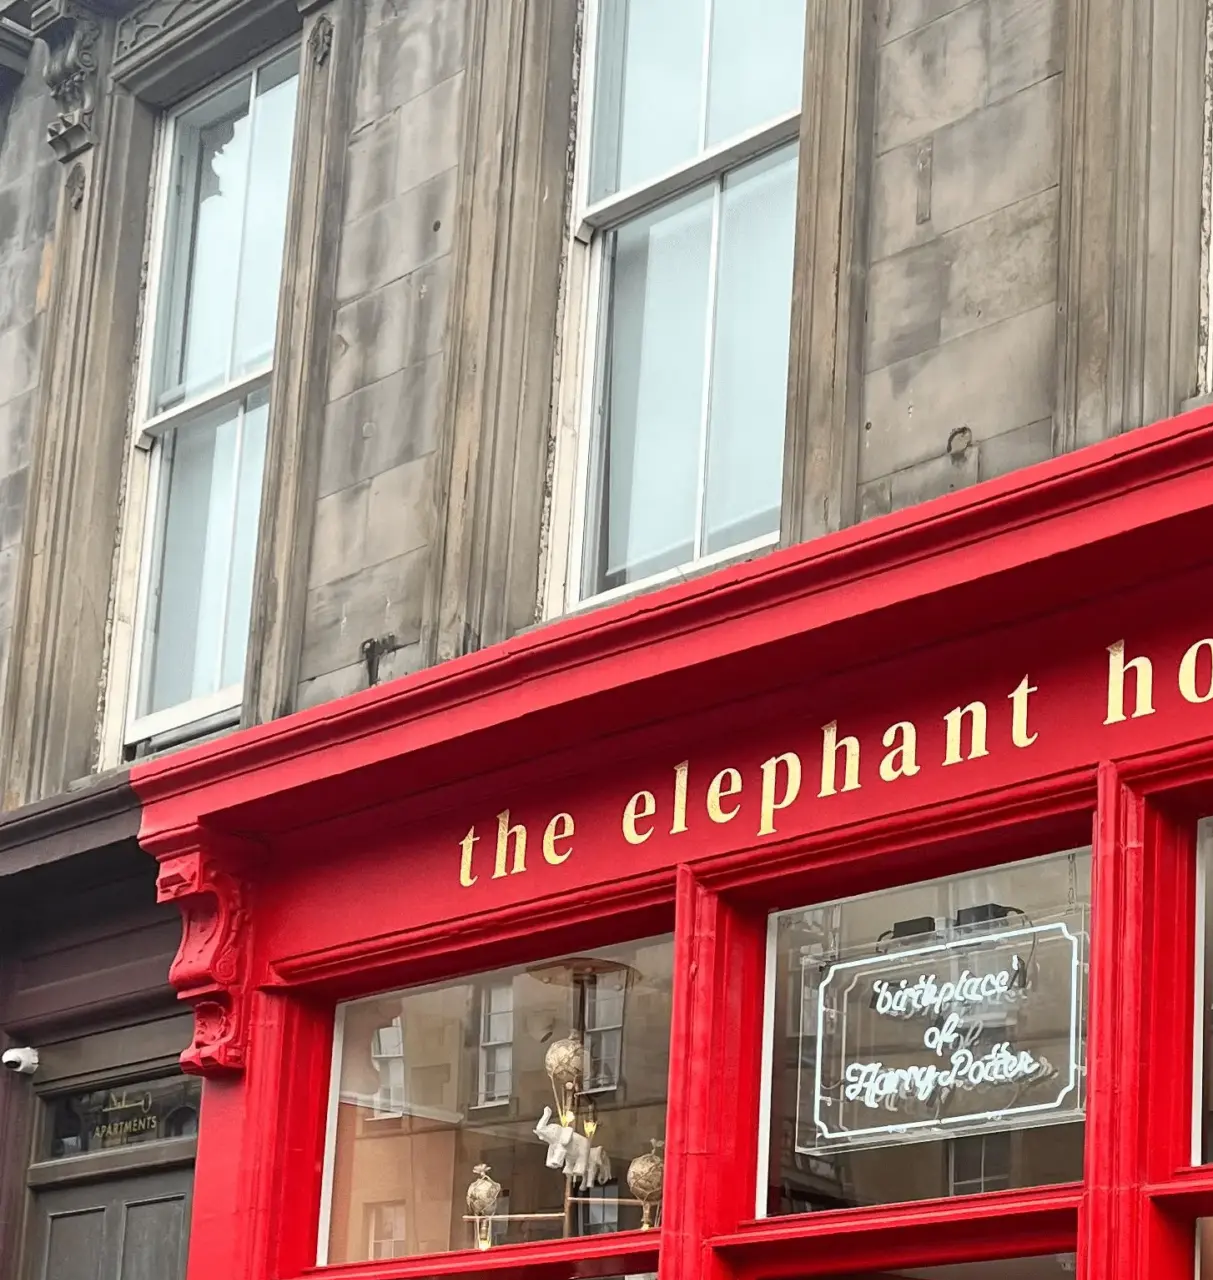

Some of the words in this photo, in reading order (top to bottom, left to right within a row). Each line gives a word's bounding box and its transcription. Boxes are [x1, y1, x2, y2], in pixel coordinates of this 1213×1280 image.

[457, 807, 575, 888] the
[621, 672, 1040, 835] elephant
[924, 1012, 963, 1056] of
[845, 1061, 944, 1108] Harry
[938, 1041, 1040, 1085] Potter
[93, 1115, 157, 1138] APARTMENTS
